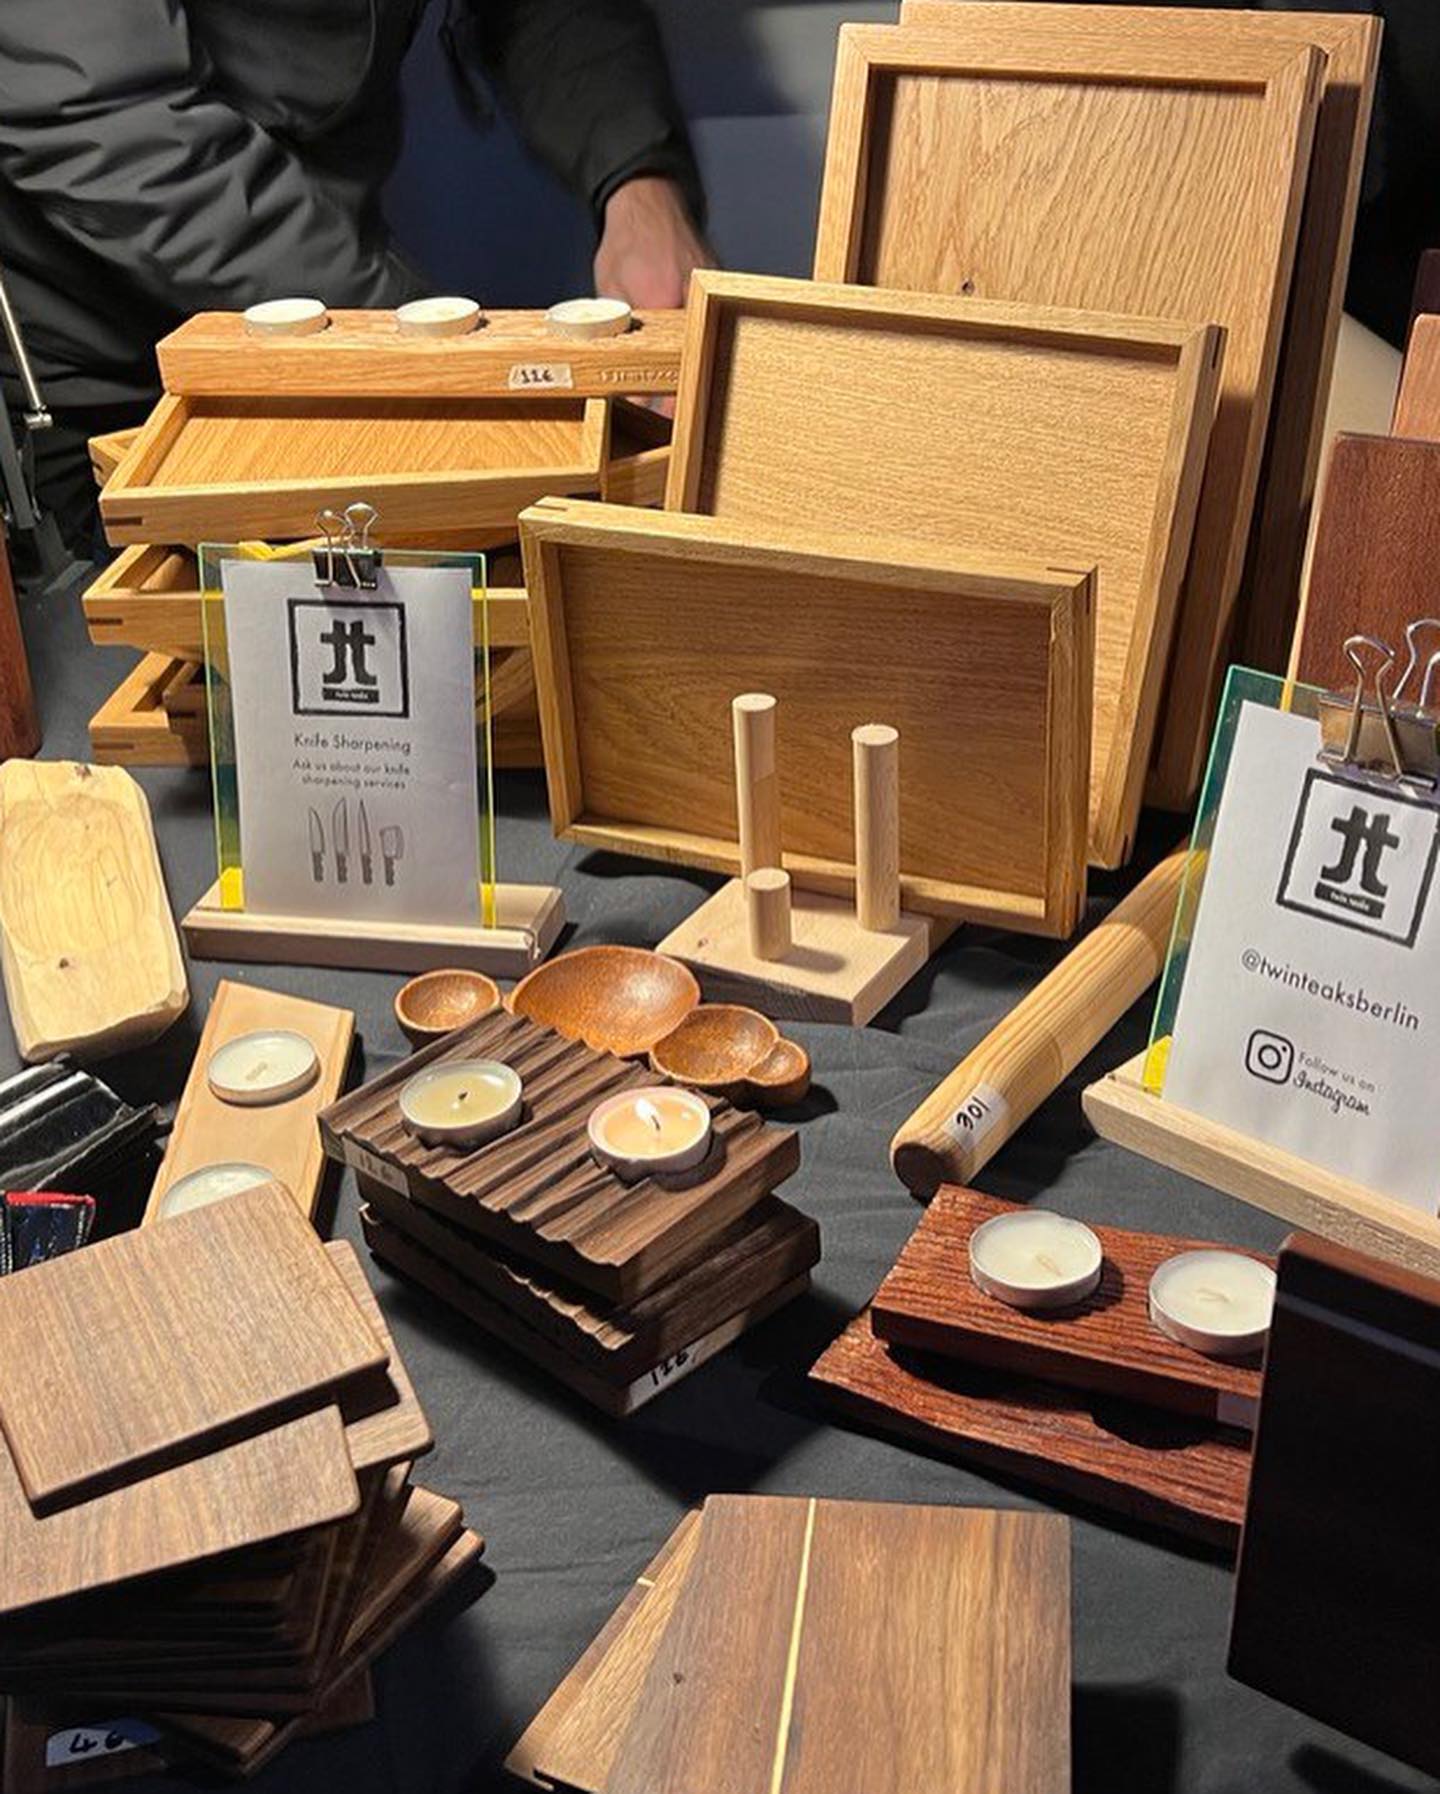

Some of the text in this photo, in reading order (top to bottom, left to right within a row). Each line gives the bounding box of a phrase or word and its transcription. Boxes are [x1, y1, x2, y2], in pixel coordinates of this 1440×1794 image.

[294, 732, 411, 756] Knife Sharpening
[302, 775, 406, 790] sharpening services
[384, 764, 410, 776] knife
[1242, 948, 1419, 1030] @twinteaksberlin
[1298, 1051, 1376, 1093] Follow us on
[1293, 1070, 1370, 1114] Instagram
